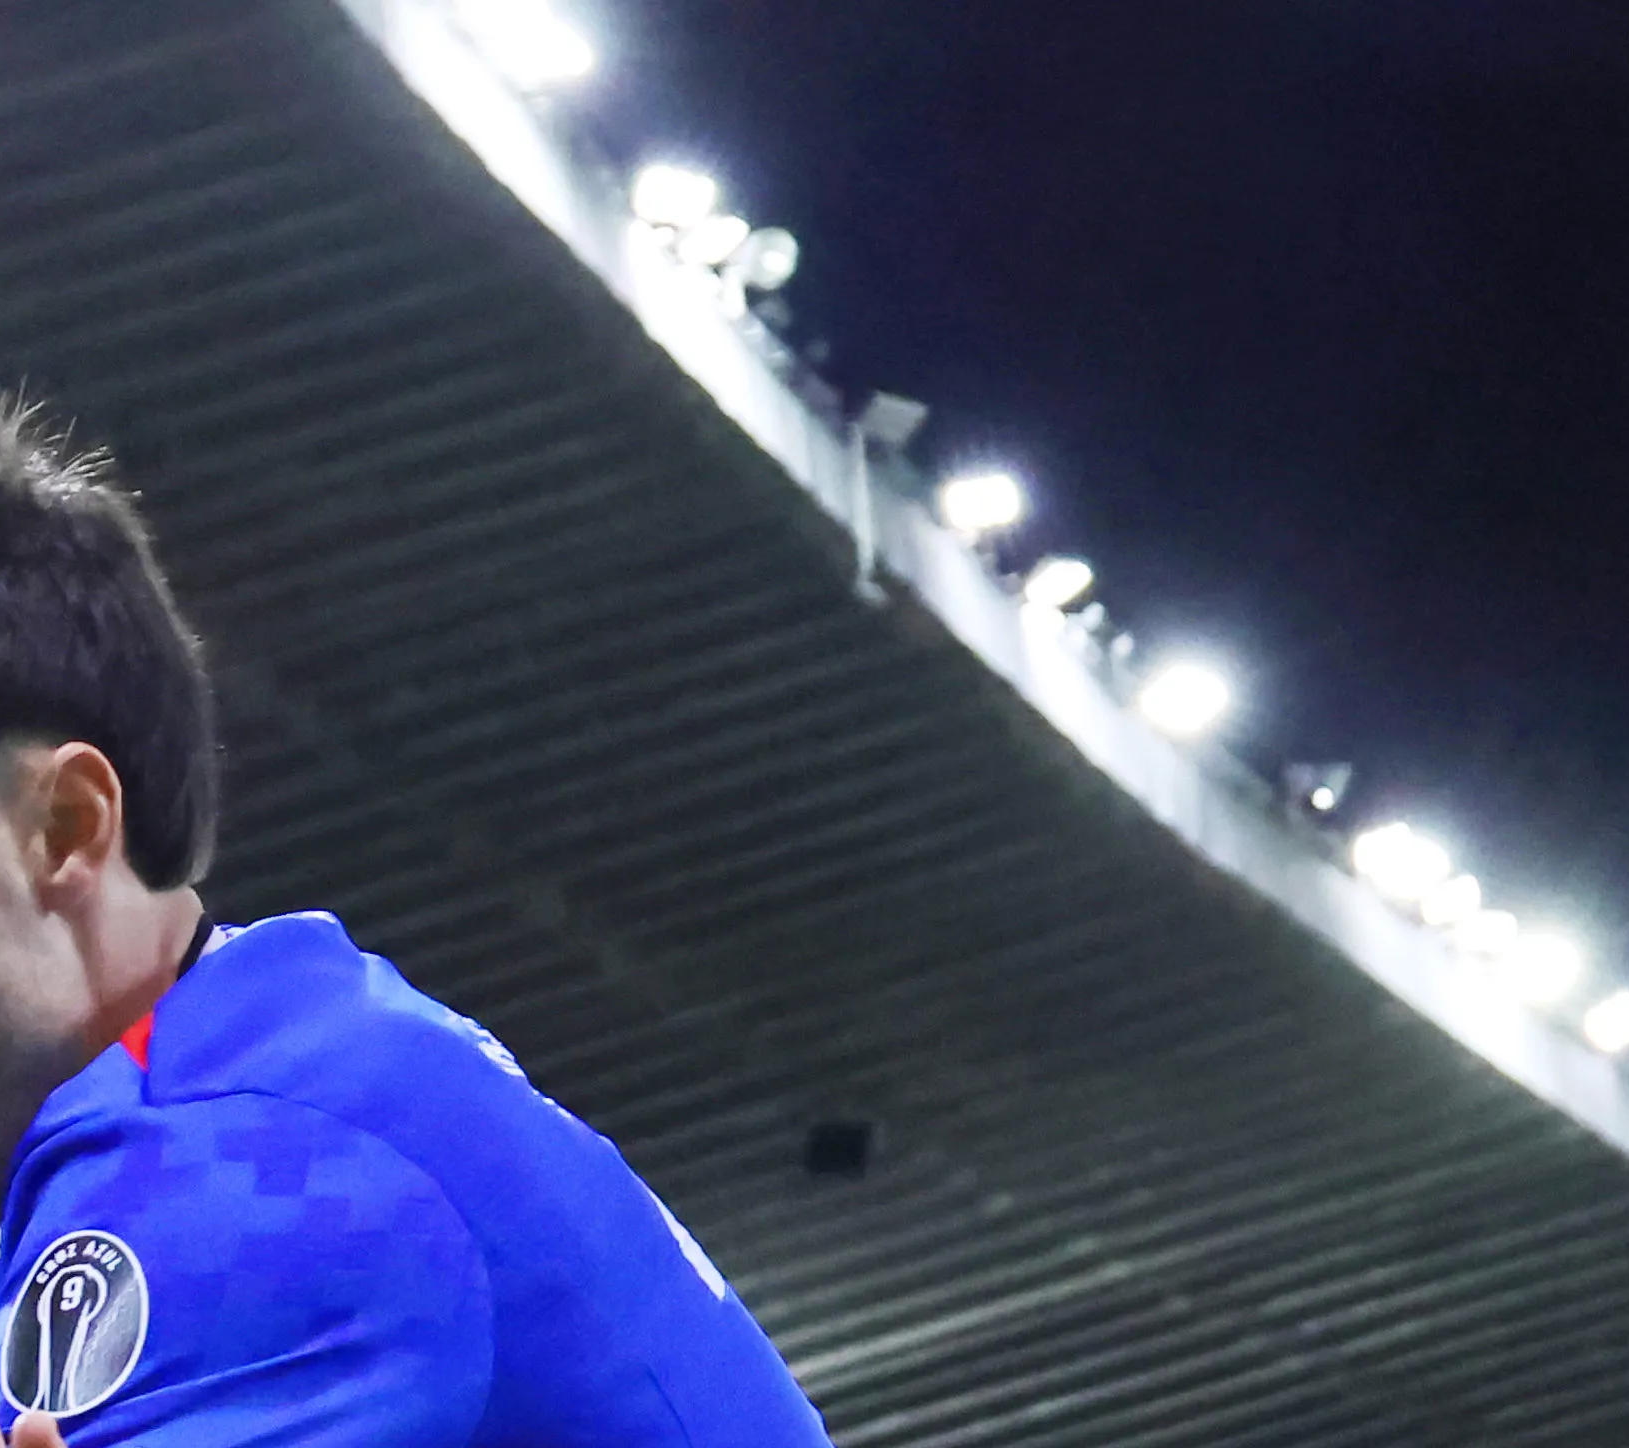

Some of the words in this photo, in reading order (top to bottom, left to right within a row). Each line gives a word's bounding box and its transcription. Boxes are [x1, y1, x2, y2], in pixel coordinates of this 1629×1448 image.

[36, 1243, 77, 1284] CRUZ
[82, 1240, 122, 1272] AZUL
[59, 1275, 85, 1312] 9
